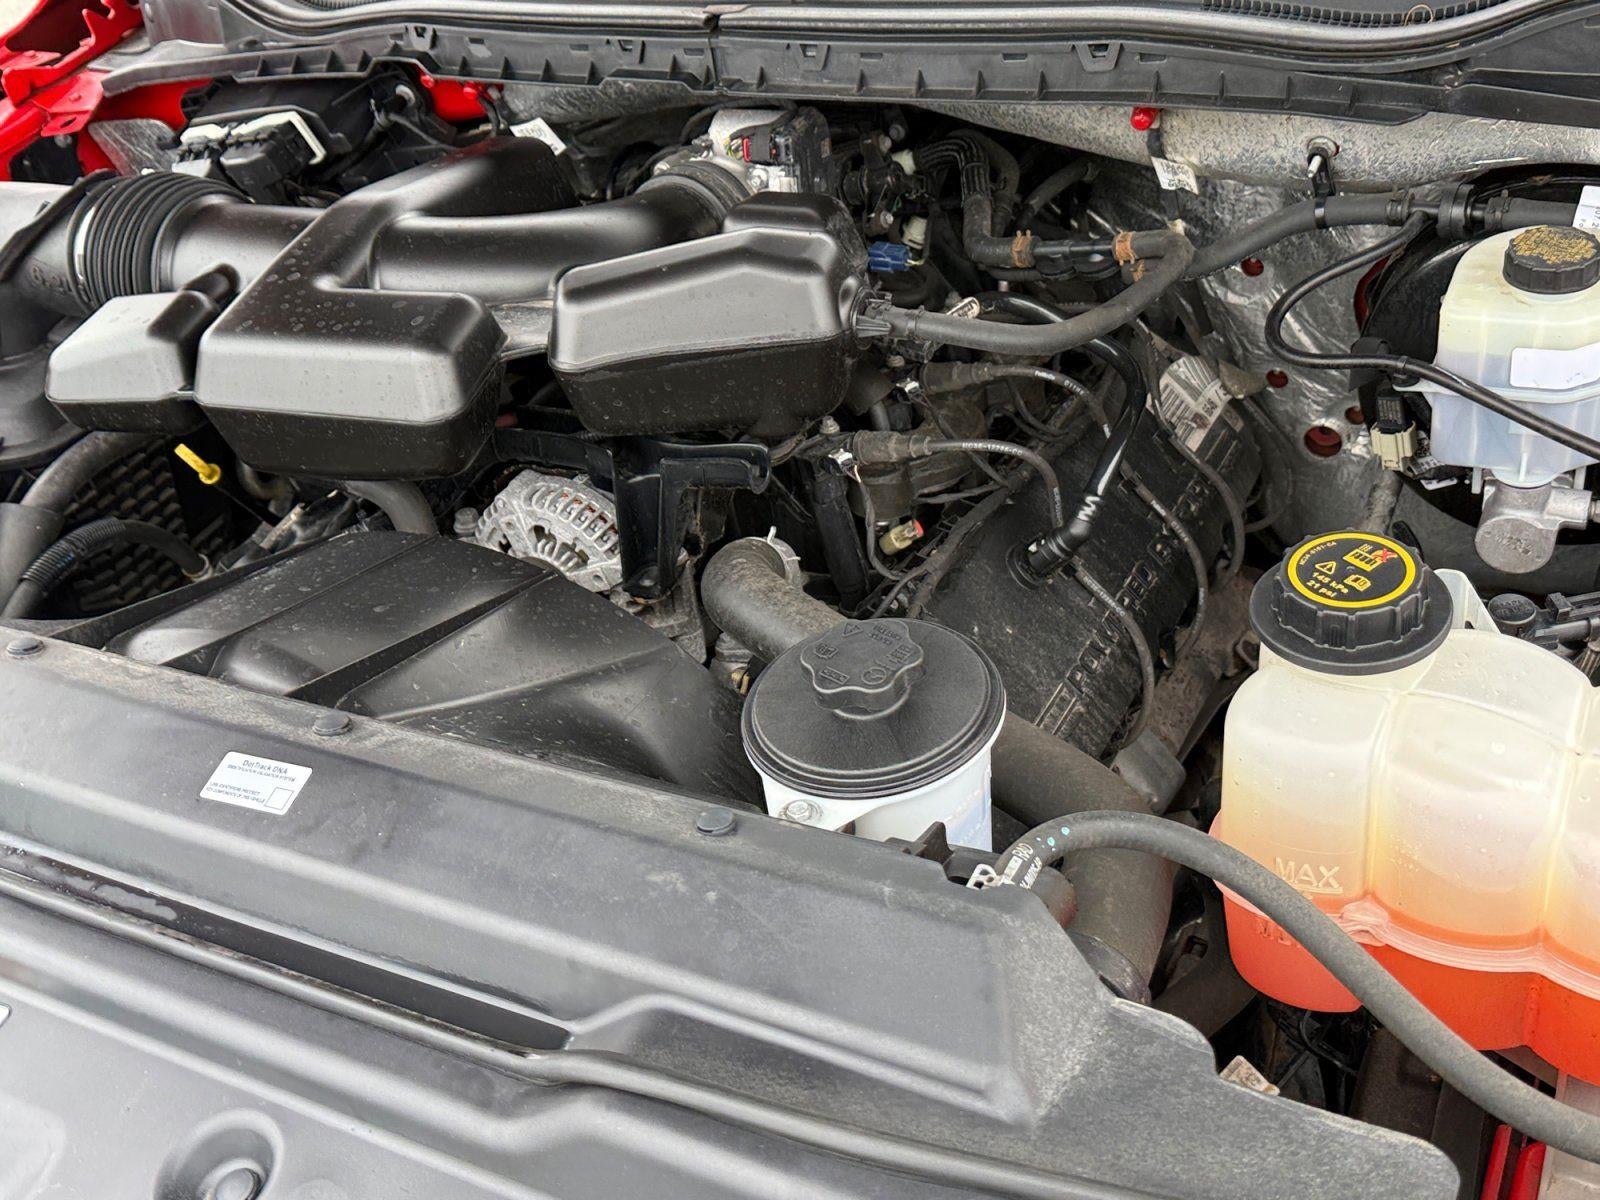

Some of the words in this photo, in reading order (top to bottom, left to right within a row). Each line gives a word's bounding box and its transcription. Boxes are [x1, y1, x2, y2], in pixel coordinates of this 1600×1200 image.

[1306, 579, 1321, 589] 21
[1319, 587, 1338, 598] psi
[1312, 572, 1331, 584] 145
[1330, 581, 1349, 594] kPa
[272, 766, 288, 775] DNA
[1275, 856, 1340, 888] MAX
